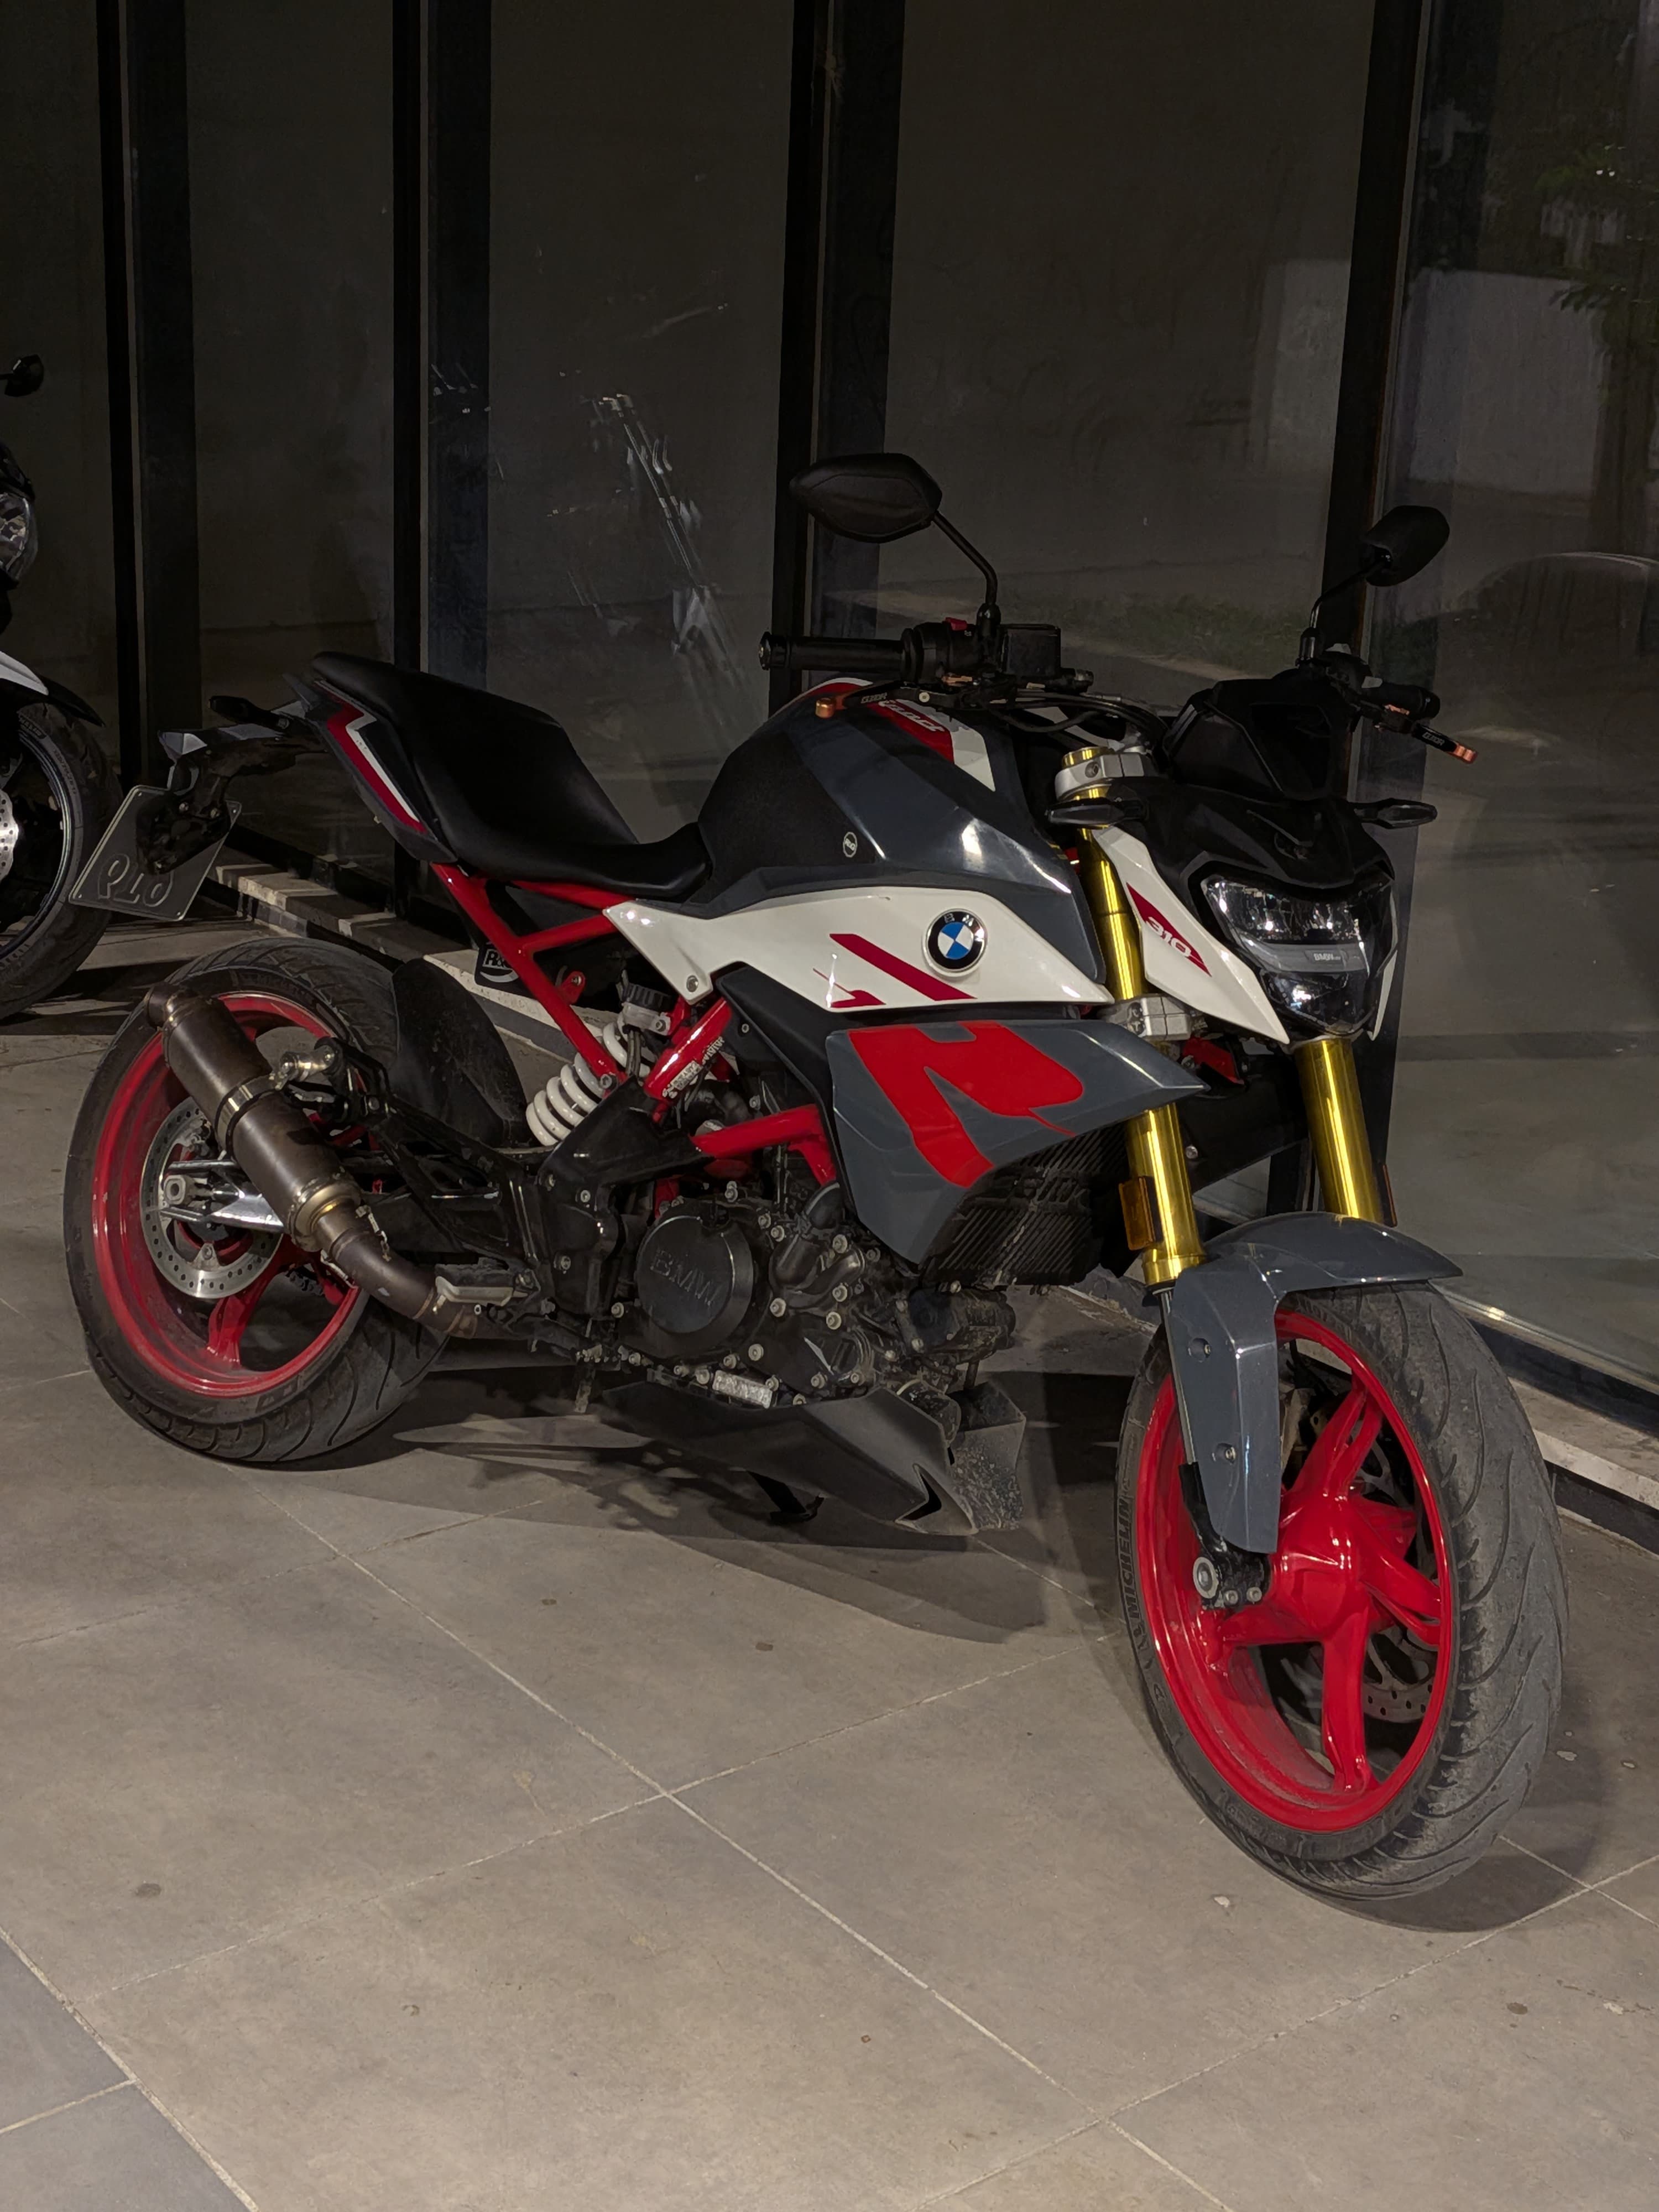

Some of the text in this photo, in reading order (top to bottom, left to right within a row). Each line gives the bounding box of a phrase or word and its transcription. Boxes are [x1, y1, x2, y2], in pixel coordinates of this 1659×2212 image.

[1146, 915, 1193, 959] 310
[650, 1248, 721, 1306] BMW
[1117, 1496, 1141, 1620] MICHELIN
